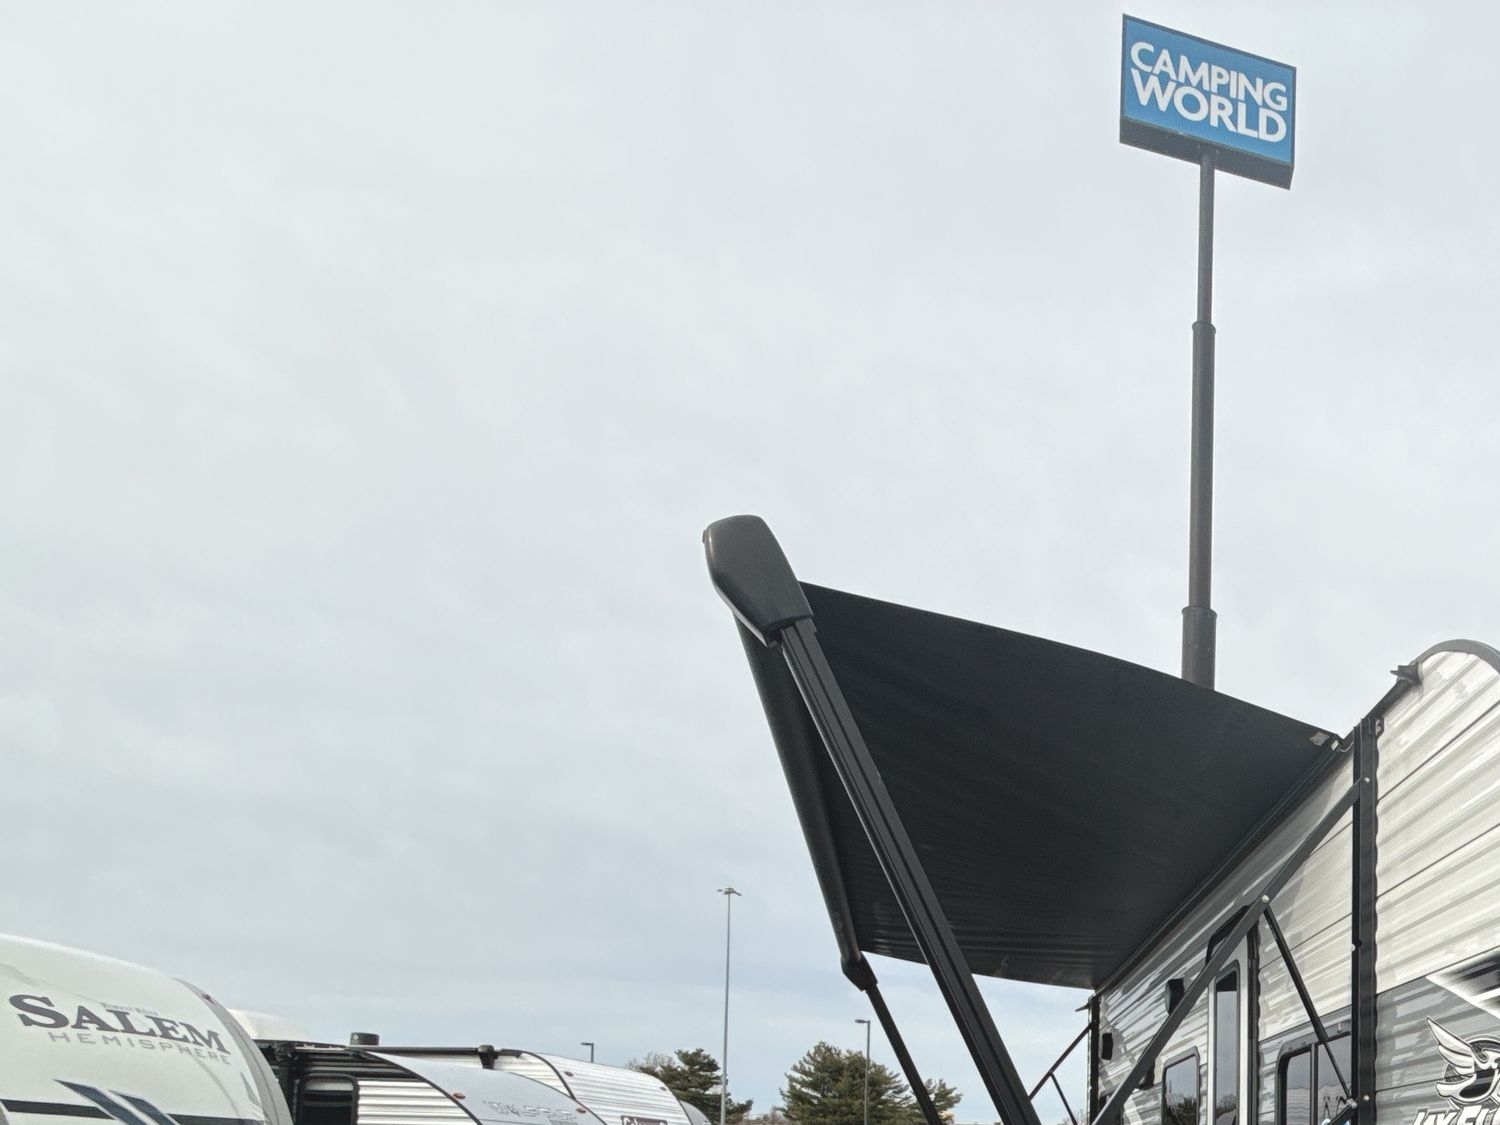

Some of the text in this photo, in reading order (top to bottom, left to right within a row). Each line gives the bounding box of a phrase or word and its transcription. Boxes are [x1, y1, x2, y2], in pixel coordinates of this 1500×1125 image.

[1130, 41, 1288, 112] CAMPING
[1130, 68, 1288, 143] WORLD
[8, 993, 232, 1055] SALEM
[48, 1031, 232, 1066] HEMISPHERE
